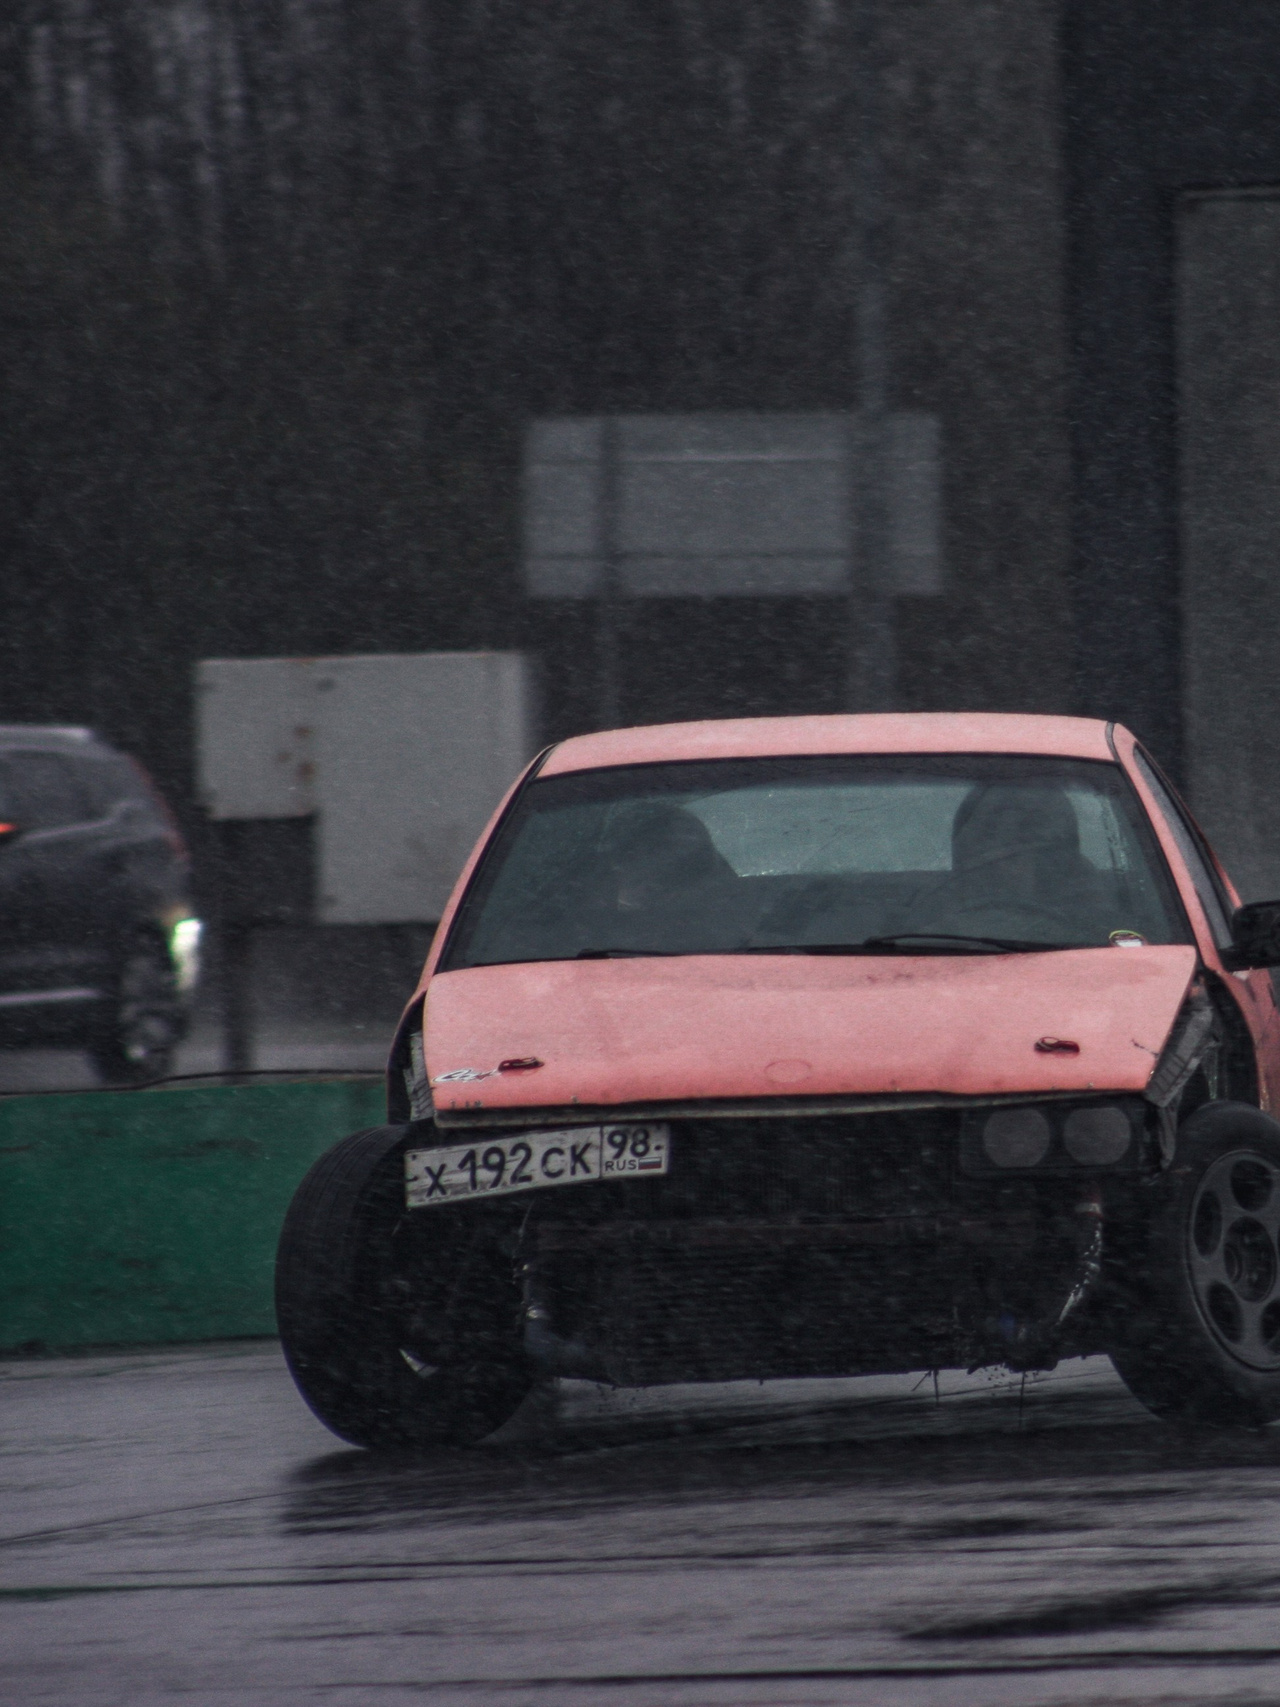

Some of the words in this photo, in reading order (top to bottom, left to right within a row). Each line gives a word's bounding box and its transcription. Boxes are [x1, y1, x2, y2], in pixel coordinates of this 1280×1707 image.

[424, 1142, 592, 1198] X192CK
[607, 1129, 650, 1159] 98
[604, 1158, 637, 1172] RUS
